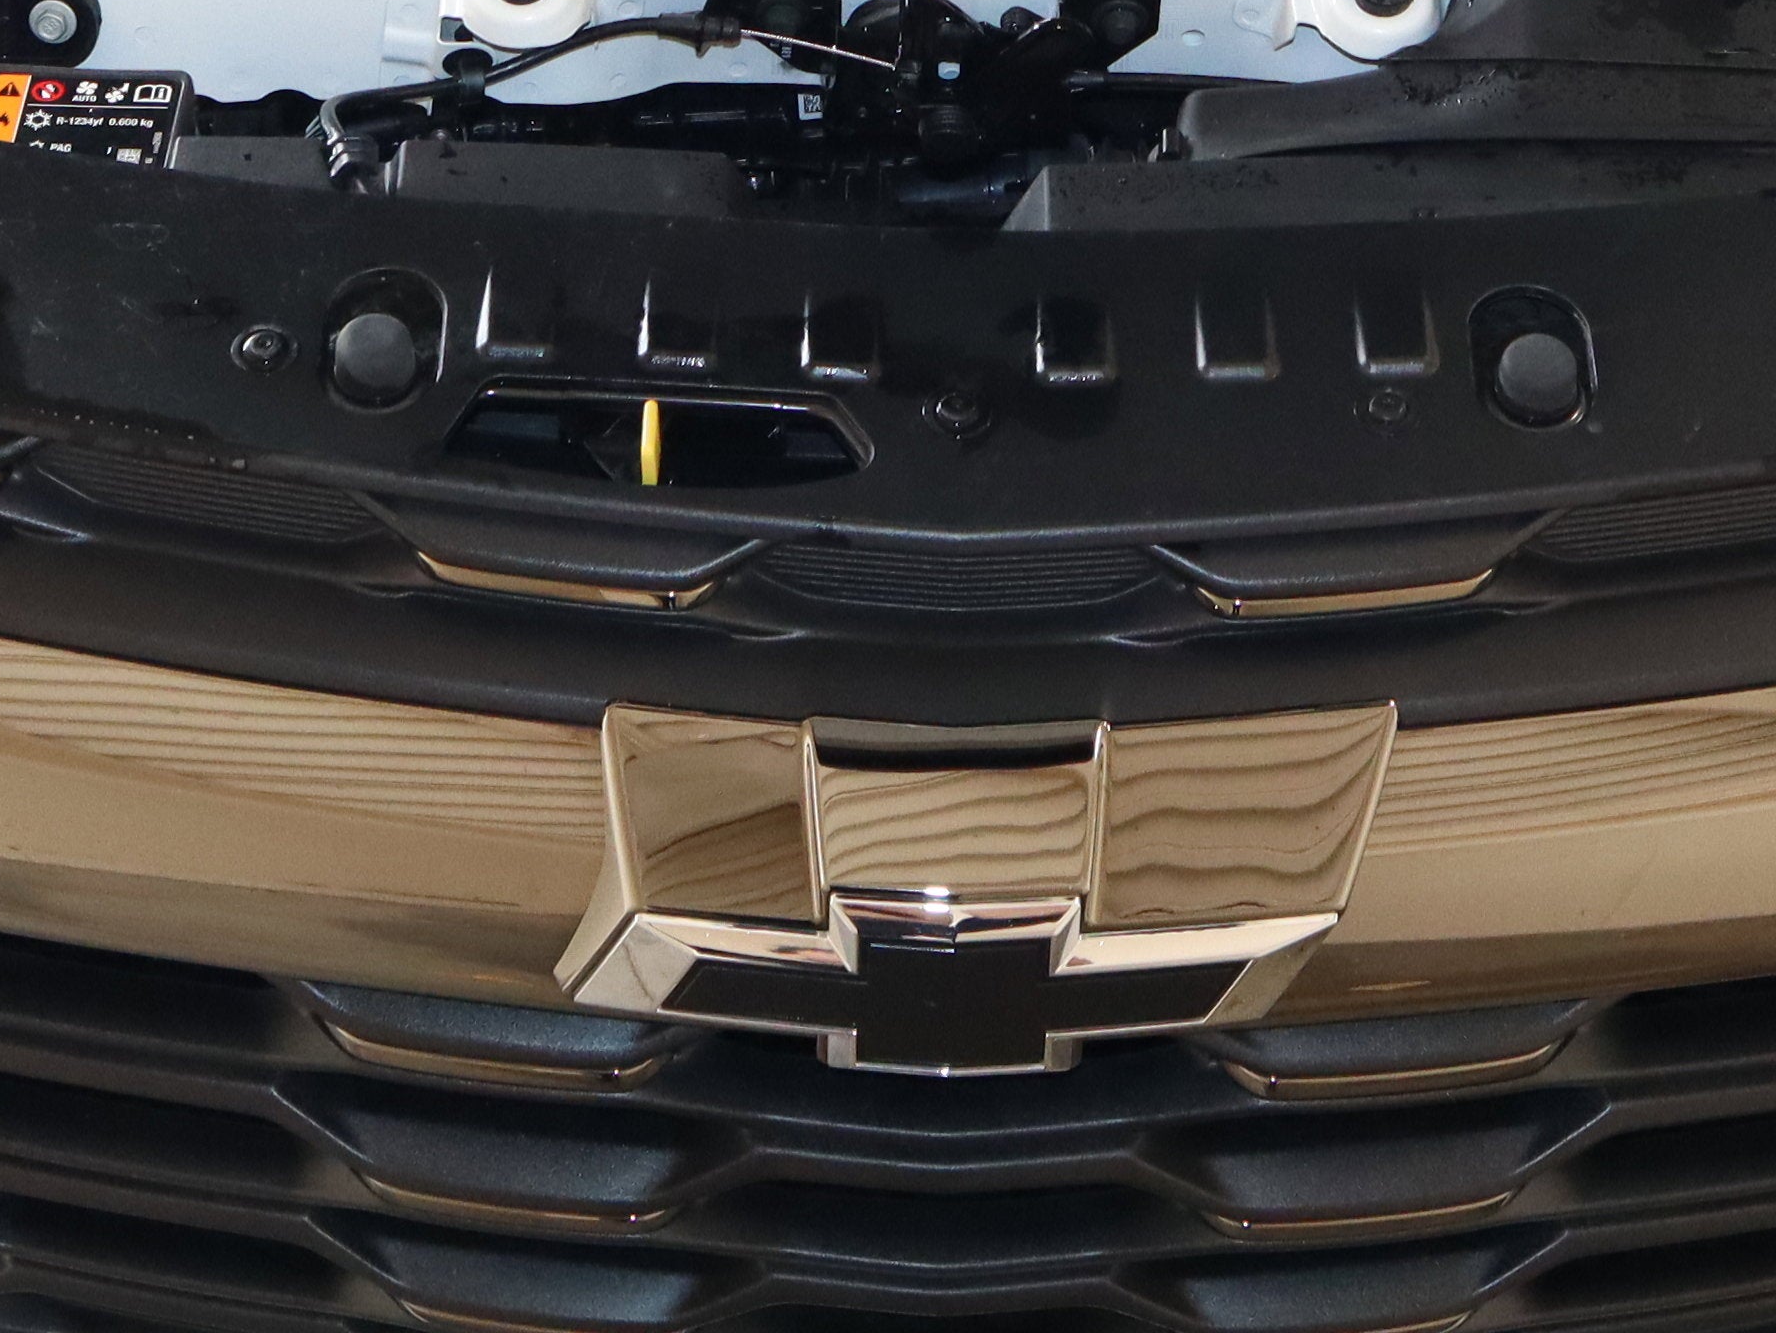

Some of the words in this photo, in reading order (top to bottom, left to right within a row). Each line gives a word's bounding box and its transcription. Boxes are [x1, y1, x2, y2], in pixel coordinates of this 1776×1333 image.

[72, 94, 98, 103] AUTO
[56, 116, 104, 127] R-1234yf
[140, 117, 154, 128] kg
[49, 142, 73, 154] PAG
